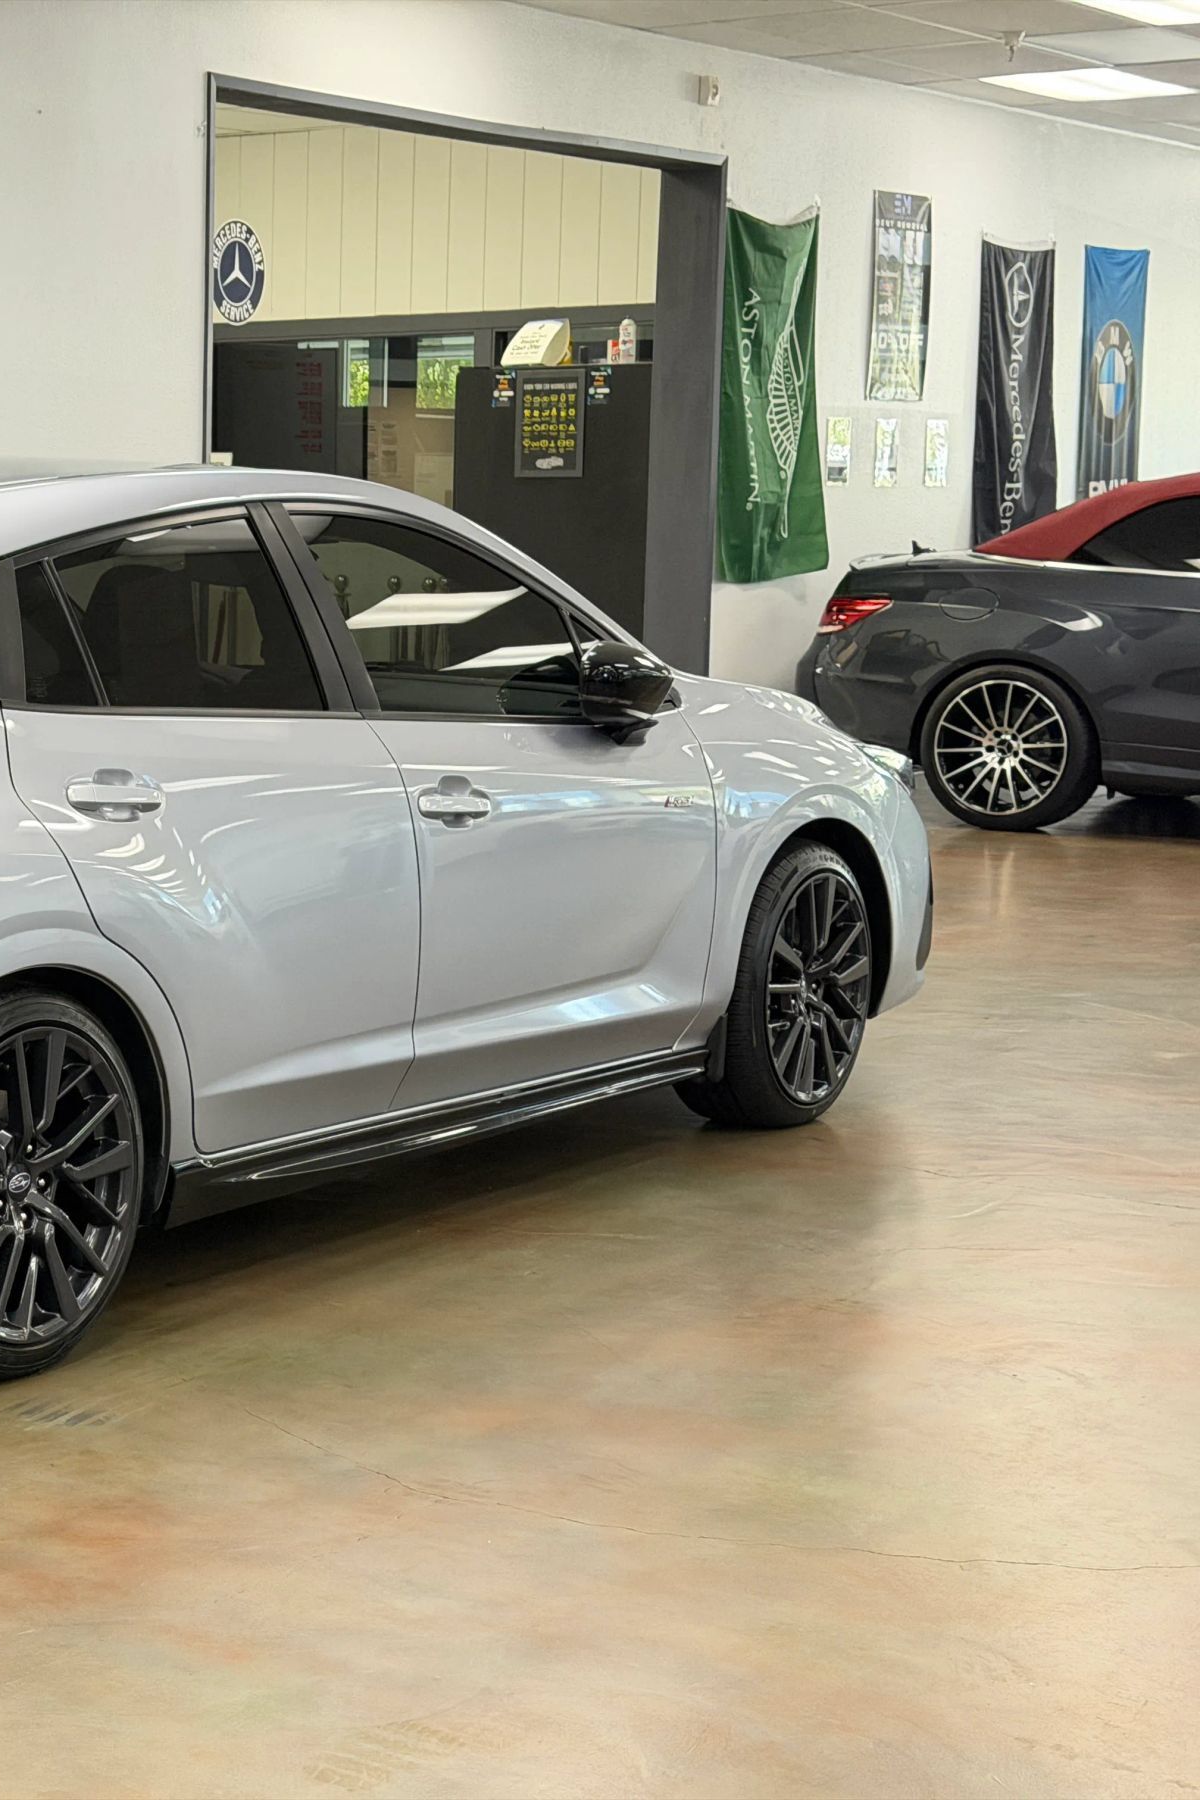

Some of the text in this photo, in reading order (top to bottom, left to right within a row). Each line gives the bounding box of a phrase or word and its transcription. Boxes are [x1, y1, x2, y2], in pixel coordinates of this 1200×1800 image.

[220, 299, 254, 321] SERVICE
[740, 287, 760, 385] ASTON
[1000, 333, 1026, 535] Mercedes-Ben
